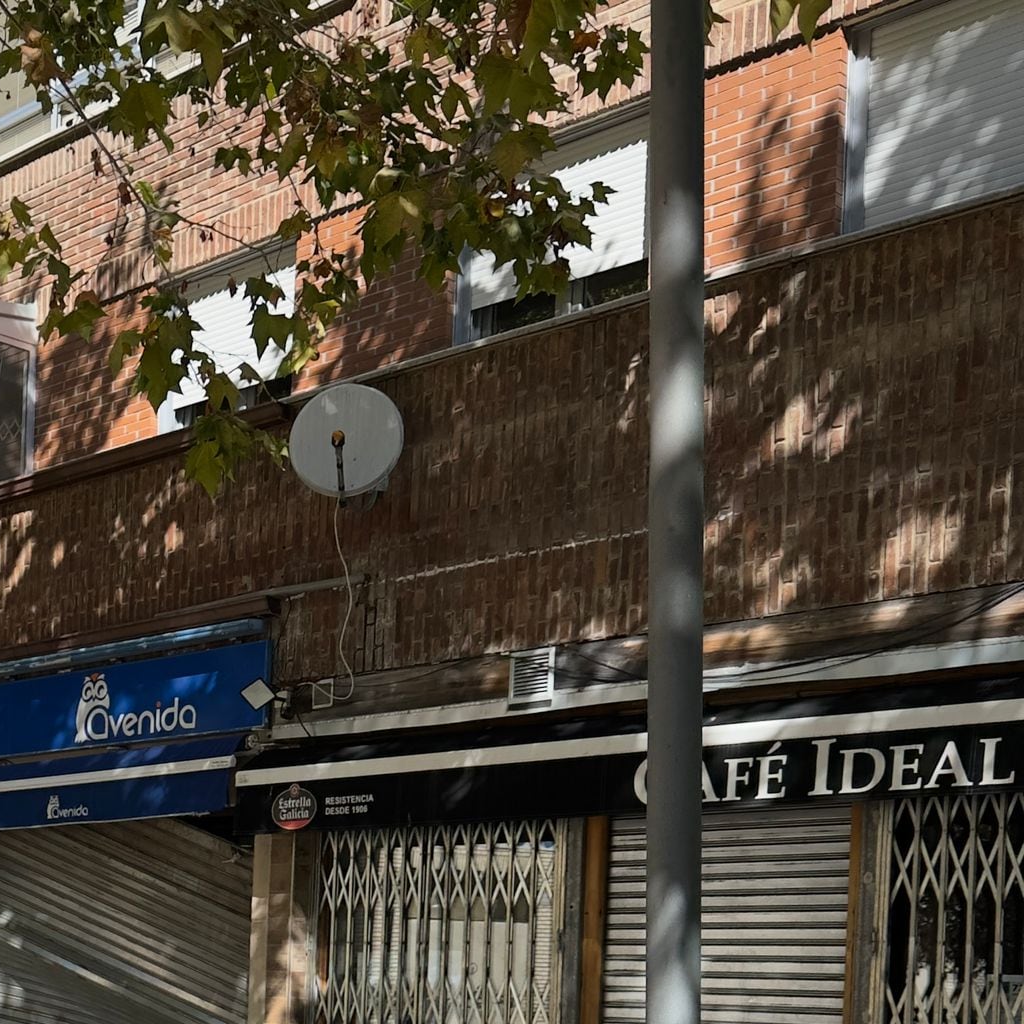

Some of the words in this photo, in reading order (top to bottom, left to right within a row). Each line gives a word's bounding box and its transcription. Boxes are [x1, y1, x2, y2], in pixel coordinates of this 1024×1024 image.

[807, 737, 1016, 797] IDEAL
[279, 797, 311, 809] Estrella
[325, 794, 374, 805] RESISTENCIA
[280, 808, 309, 820] Galicia
[325, 806, 350, 815] DESDE
[352, 805, 368, 814] 1906
